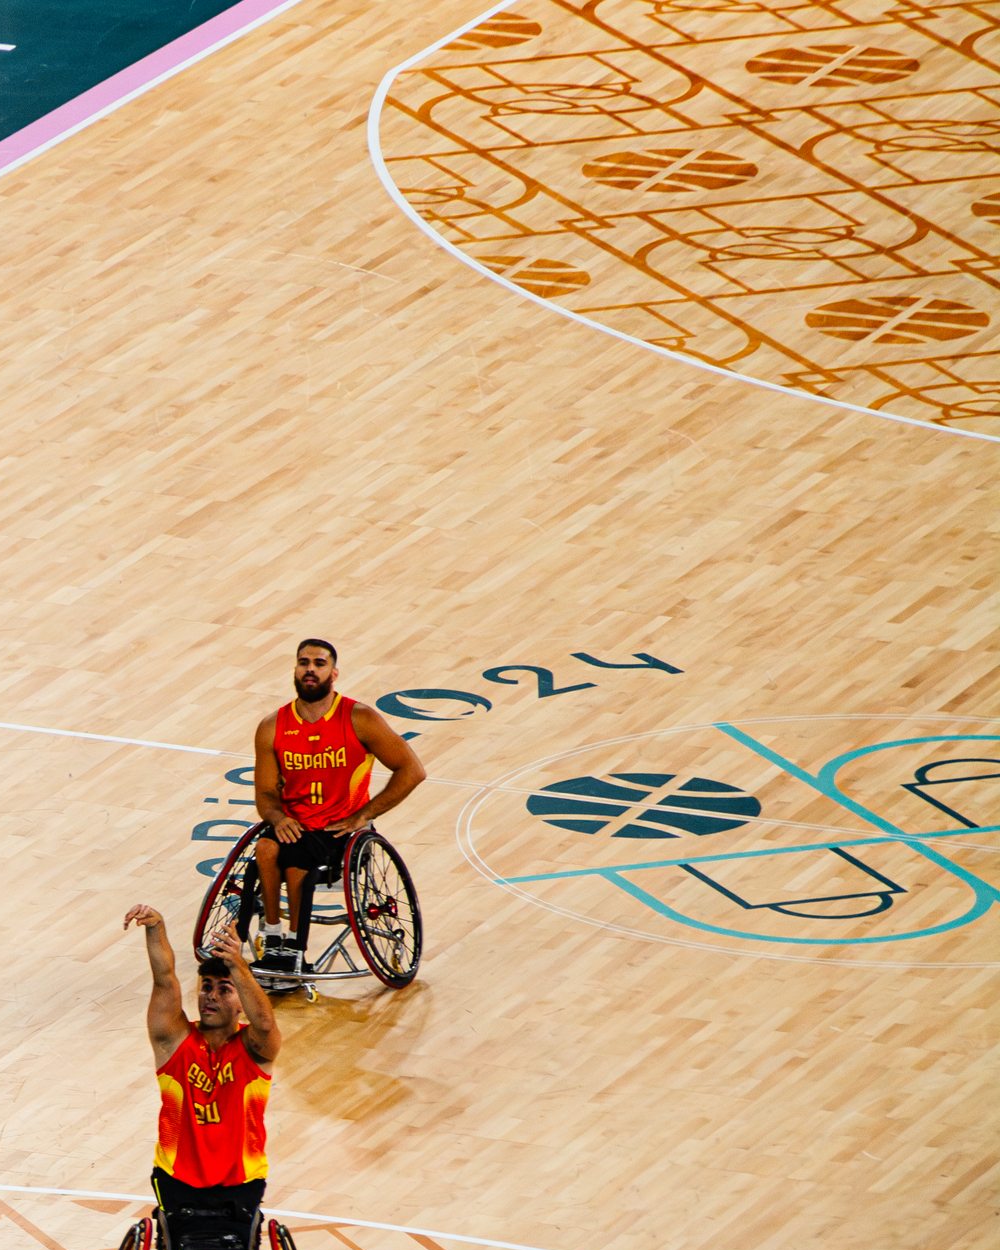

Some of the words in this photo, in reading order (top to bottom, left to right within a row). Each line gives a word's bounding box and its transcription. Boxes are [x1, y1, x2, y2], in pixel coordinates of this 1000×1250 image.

[375, 652, 685, 741] 024
[283, 746, 347, 770] ESPAÑA
[310, 781, 323, 805] 11
